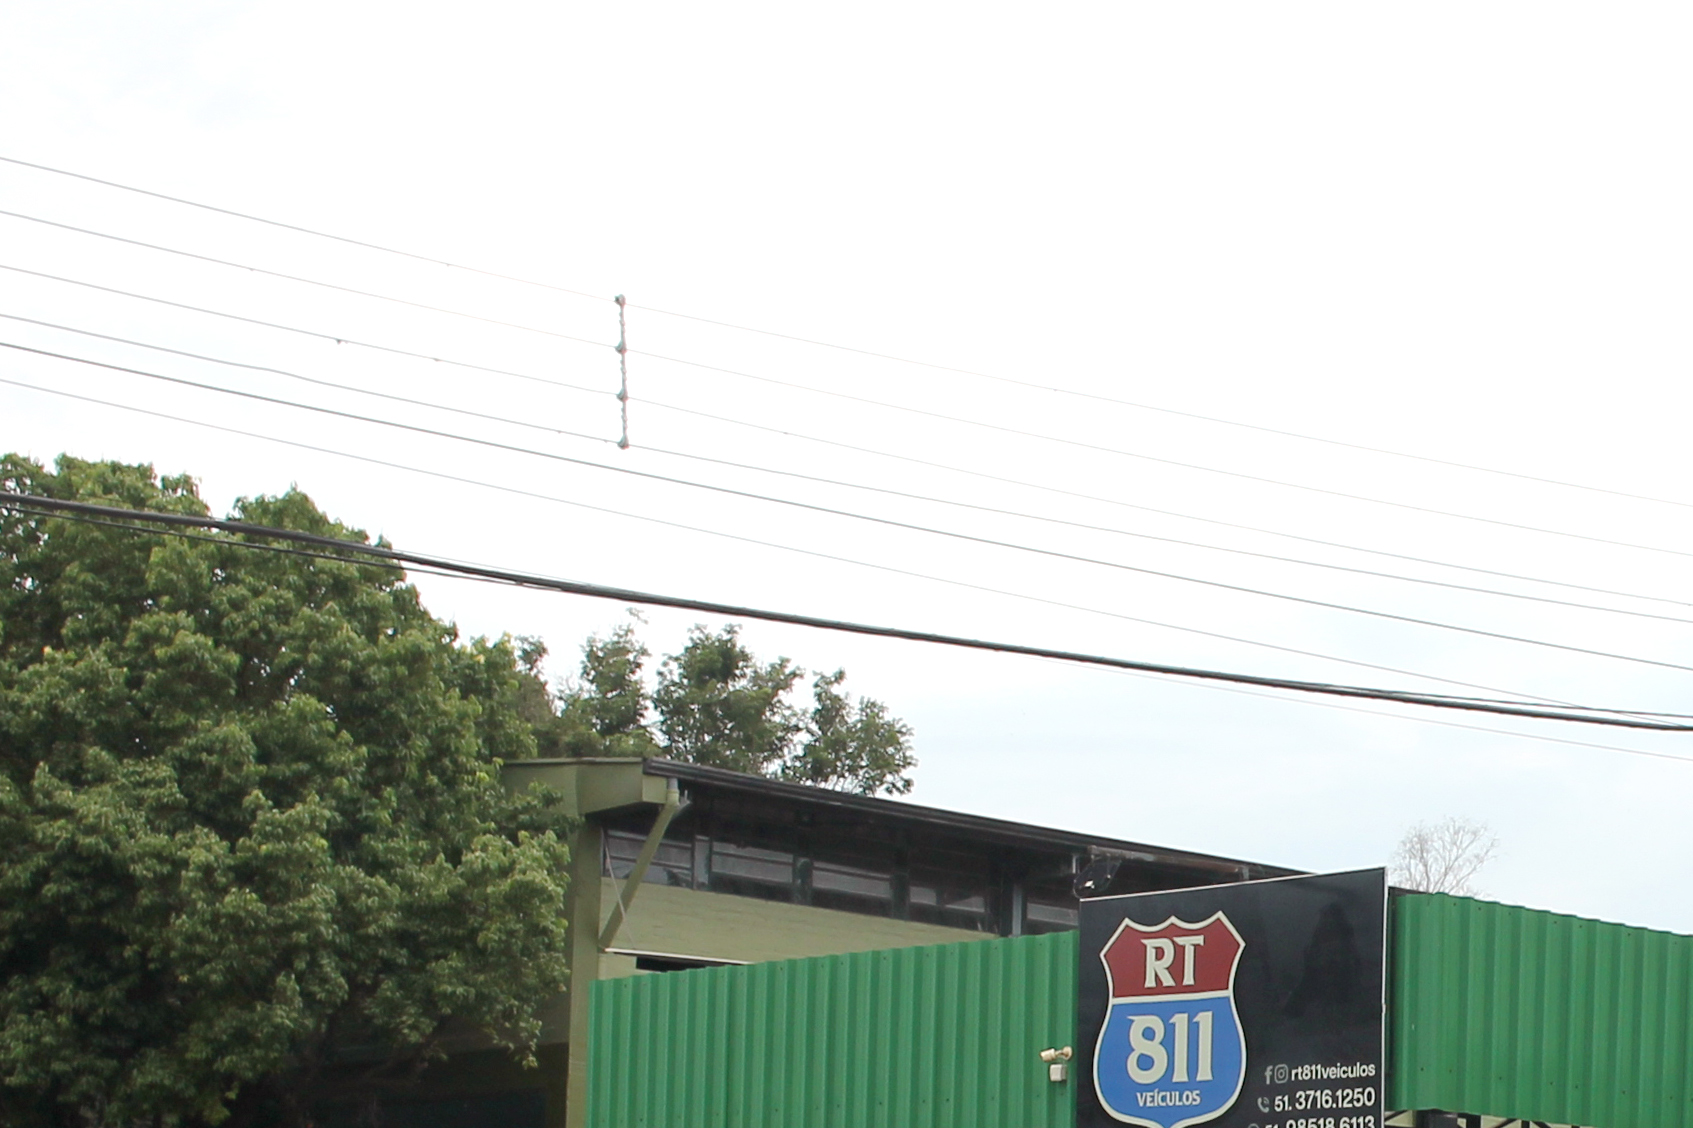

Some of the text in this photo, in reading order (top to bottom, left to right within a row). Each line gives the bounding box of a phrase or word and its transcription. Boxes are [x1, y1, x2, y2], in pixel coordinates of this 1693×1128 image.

[1140, 934, 1204, 988] RT
[1126, 1010, 1214, 1084] 811
[1291, 1061, 1376, 1082] rt811veiculos
[1136, 1087, 1201, 1107] VEÍCULOS
[1295, 1087, 1376, 1110] 3716.1250
